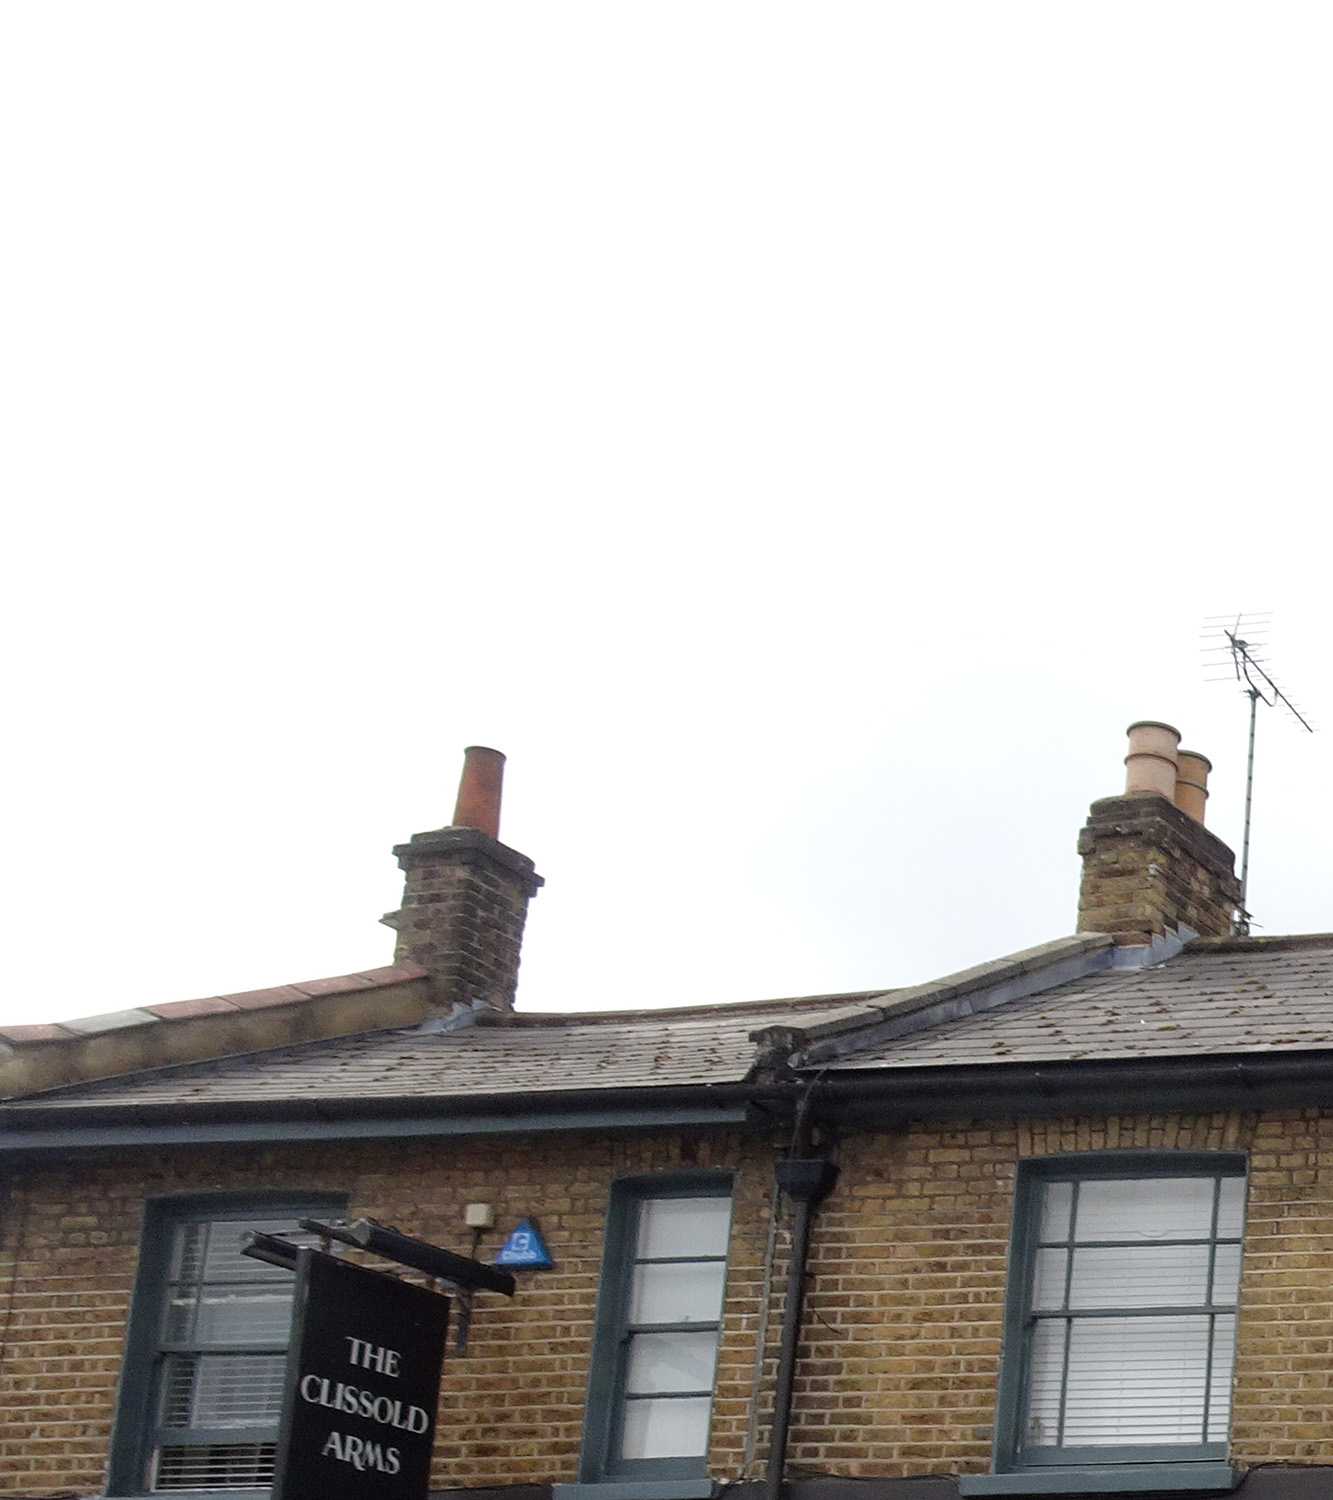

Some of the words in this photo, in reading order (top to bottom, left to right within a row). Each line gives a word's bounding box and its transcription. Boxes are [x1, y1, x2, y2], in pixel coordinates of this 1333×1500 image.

[345, 1336, 402, 1379] THE
[300, 1373, 429, 1435] CLISSOLD
[321, 1431, 401, 1475] ARMS
